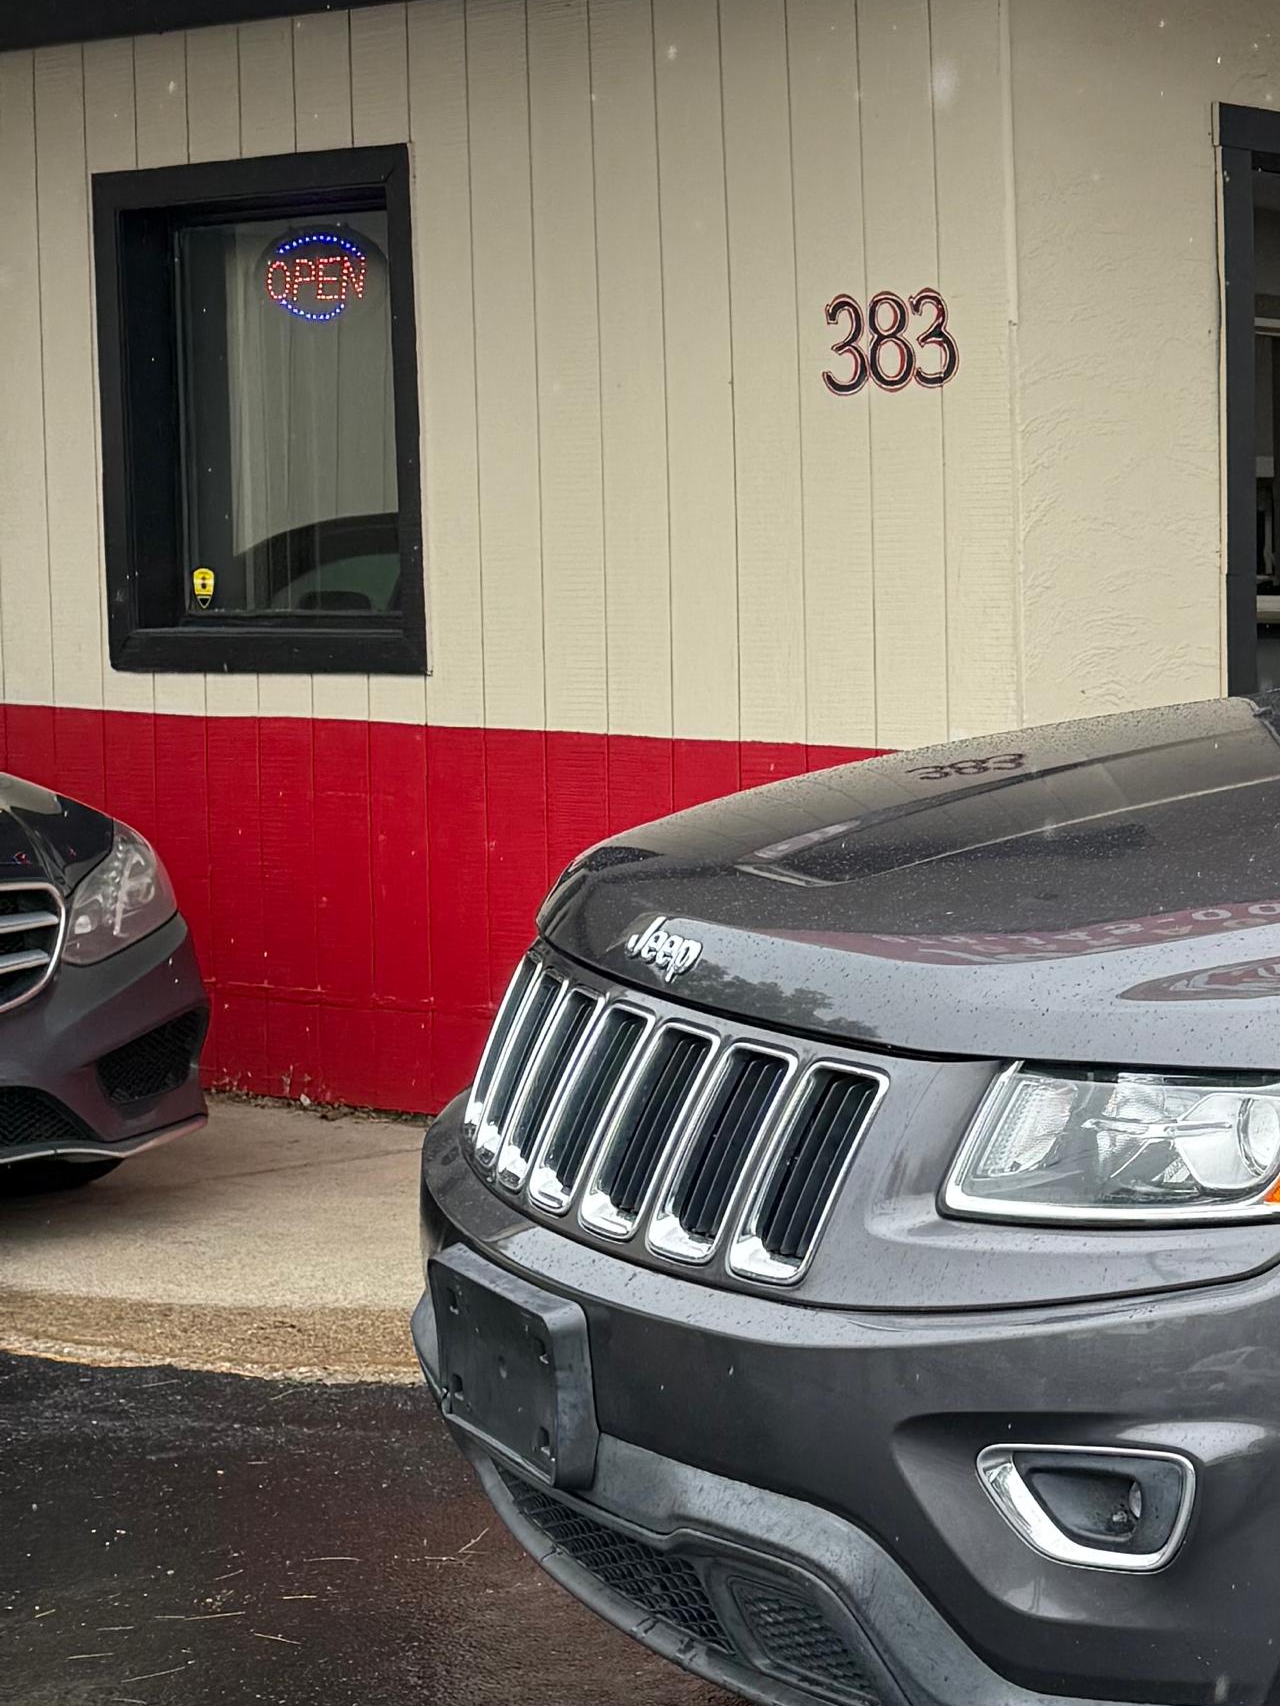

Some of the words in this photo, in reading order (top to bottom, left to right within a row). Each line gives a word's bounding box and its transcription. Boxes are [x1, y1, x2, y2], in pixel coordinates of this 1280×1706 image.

[266, 255, 366, 301] OPEN
[821, 287, 960, 397] 383
[626, 916, 703, 983] Jeep
